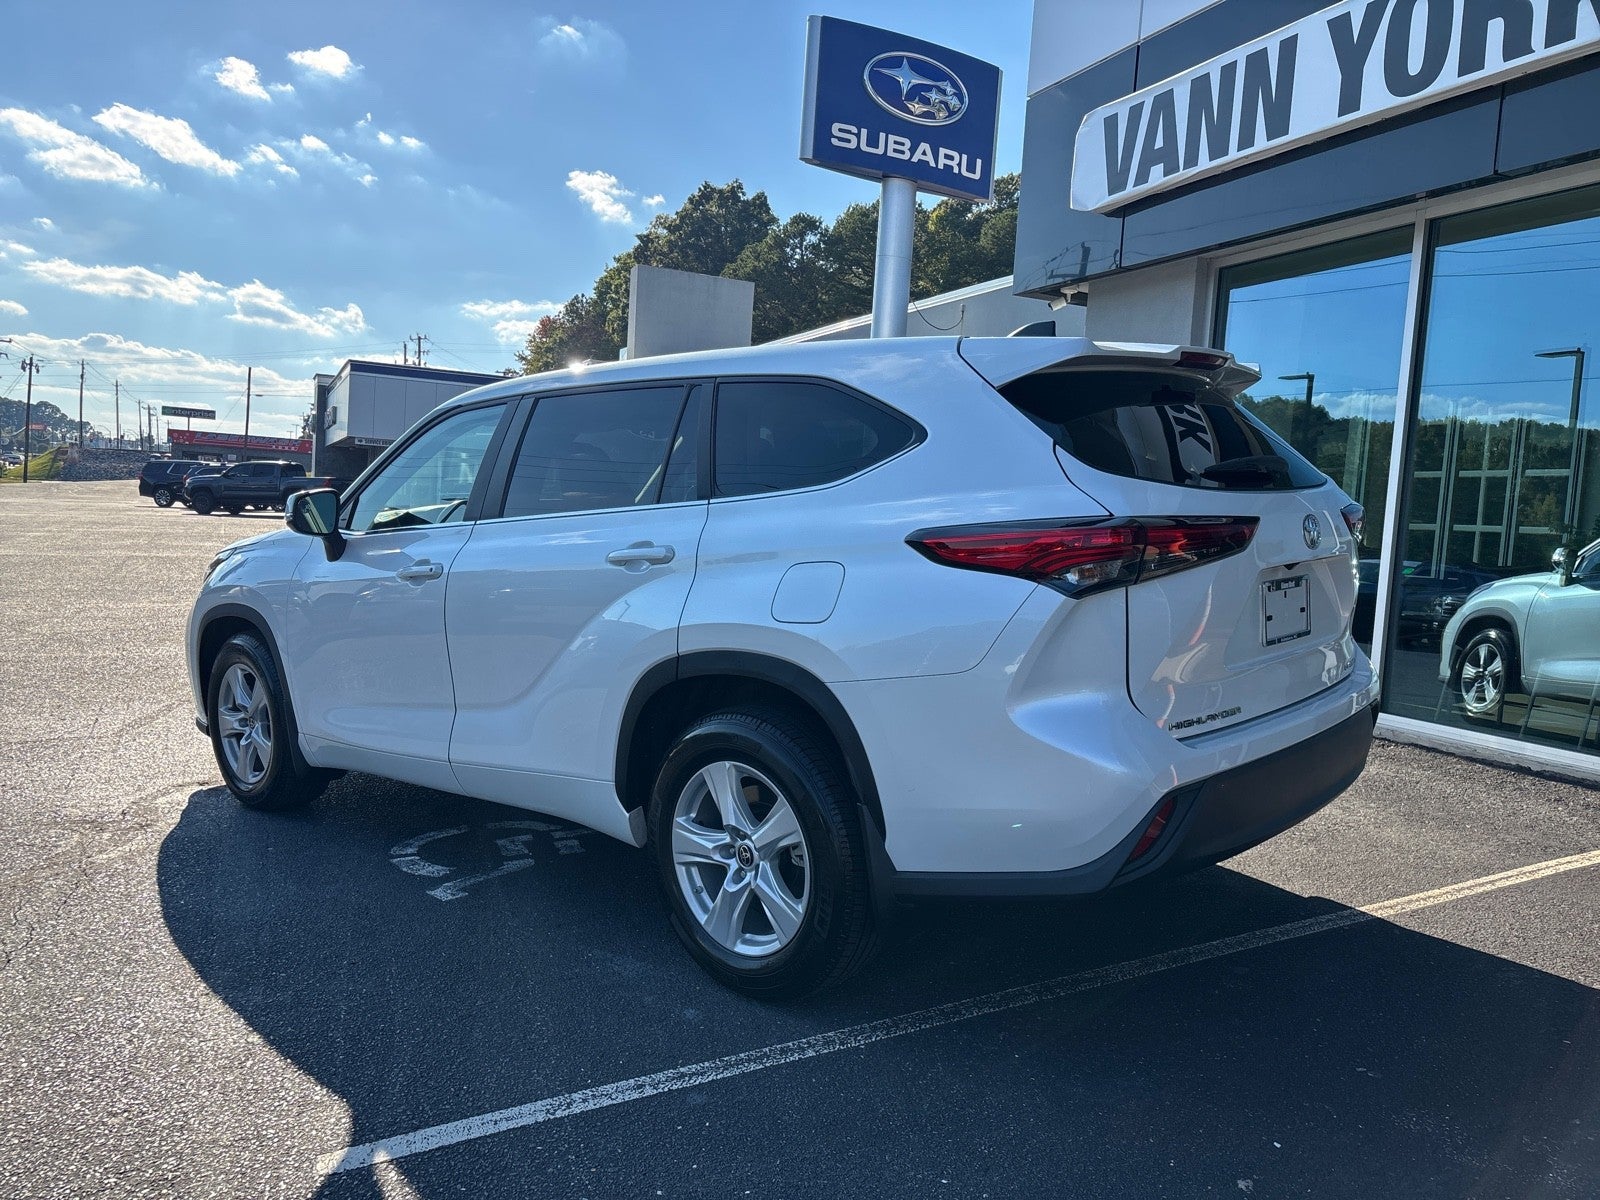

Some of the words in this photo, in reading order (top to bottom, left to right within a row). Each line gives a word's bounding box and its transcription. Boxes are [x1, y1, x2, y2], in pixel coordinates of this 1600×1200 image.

[1103, 32, 1299, 197] VANN
[830, 122, 982, 180] SUBARU
[165, 407, 215, 418] enterprise
[1168, 706, 1242, 731] HIGHLANDER
